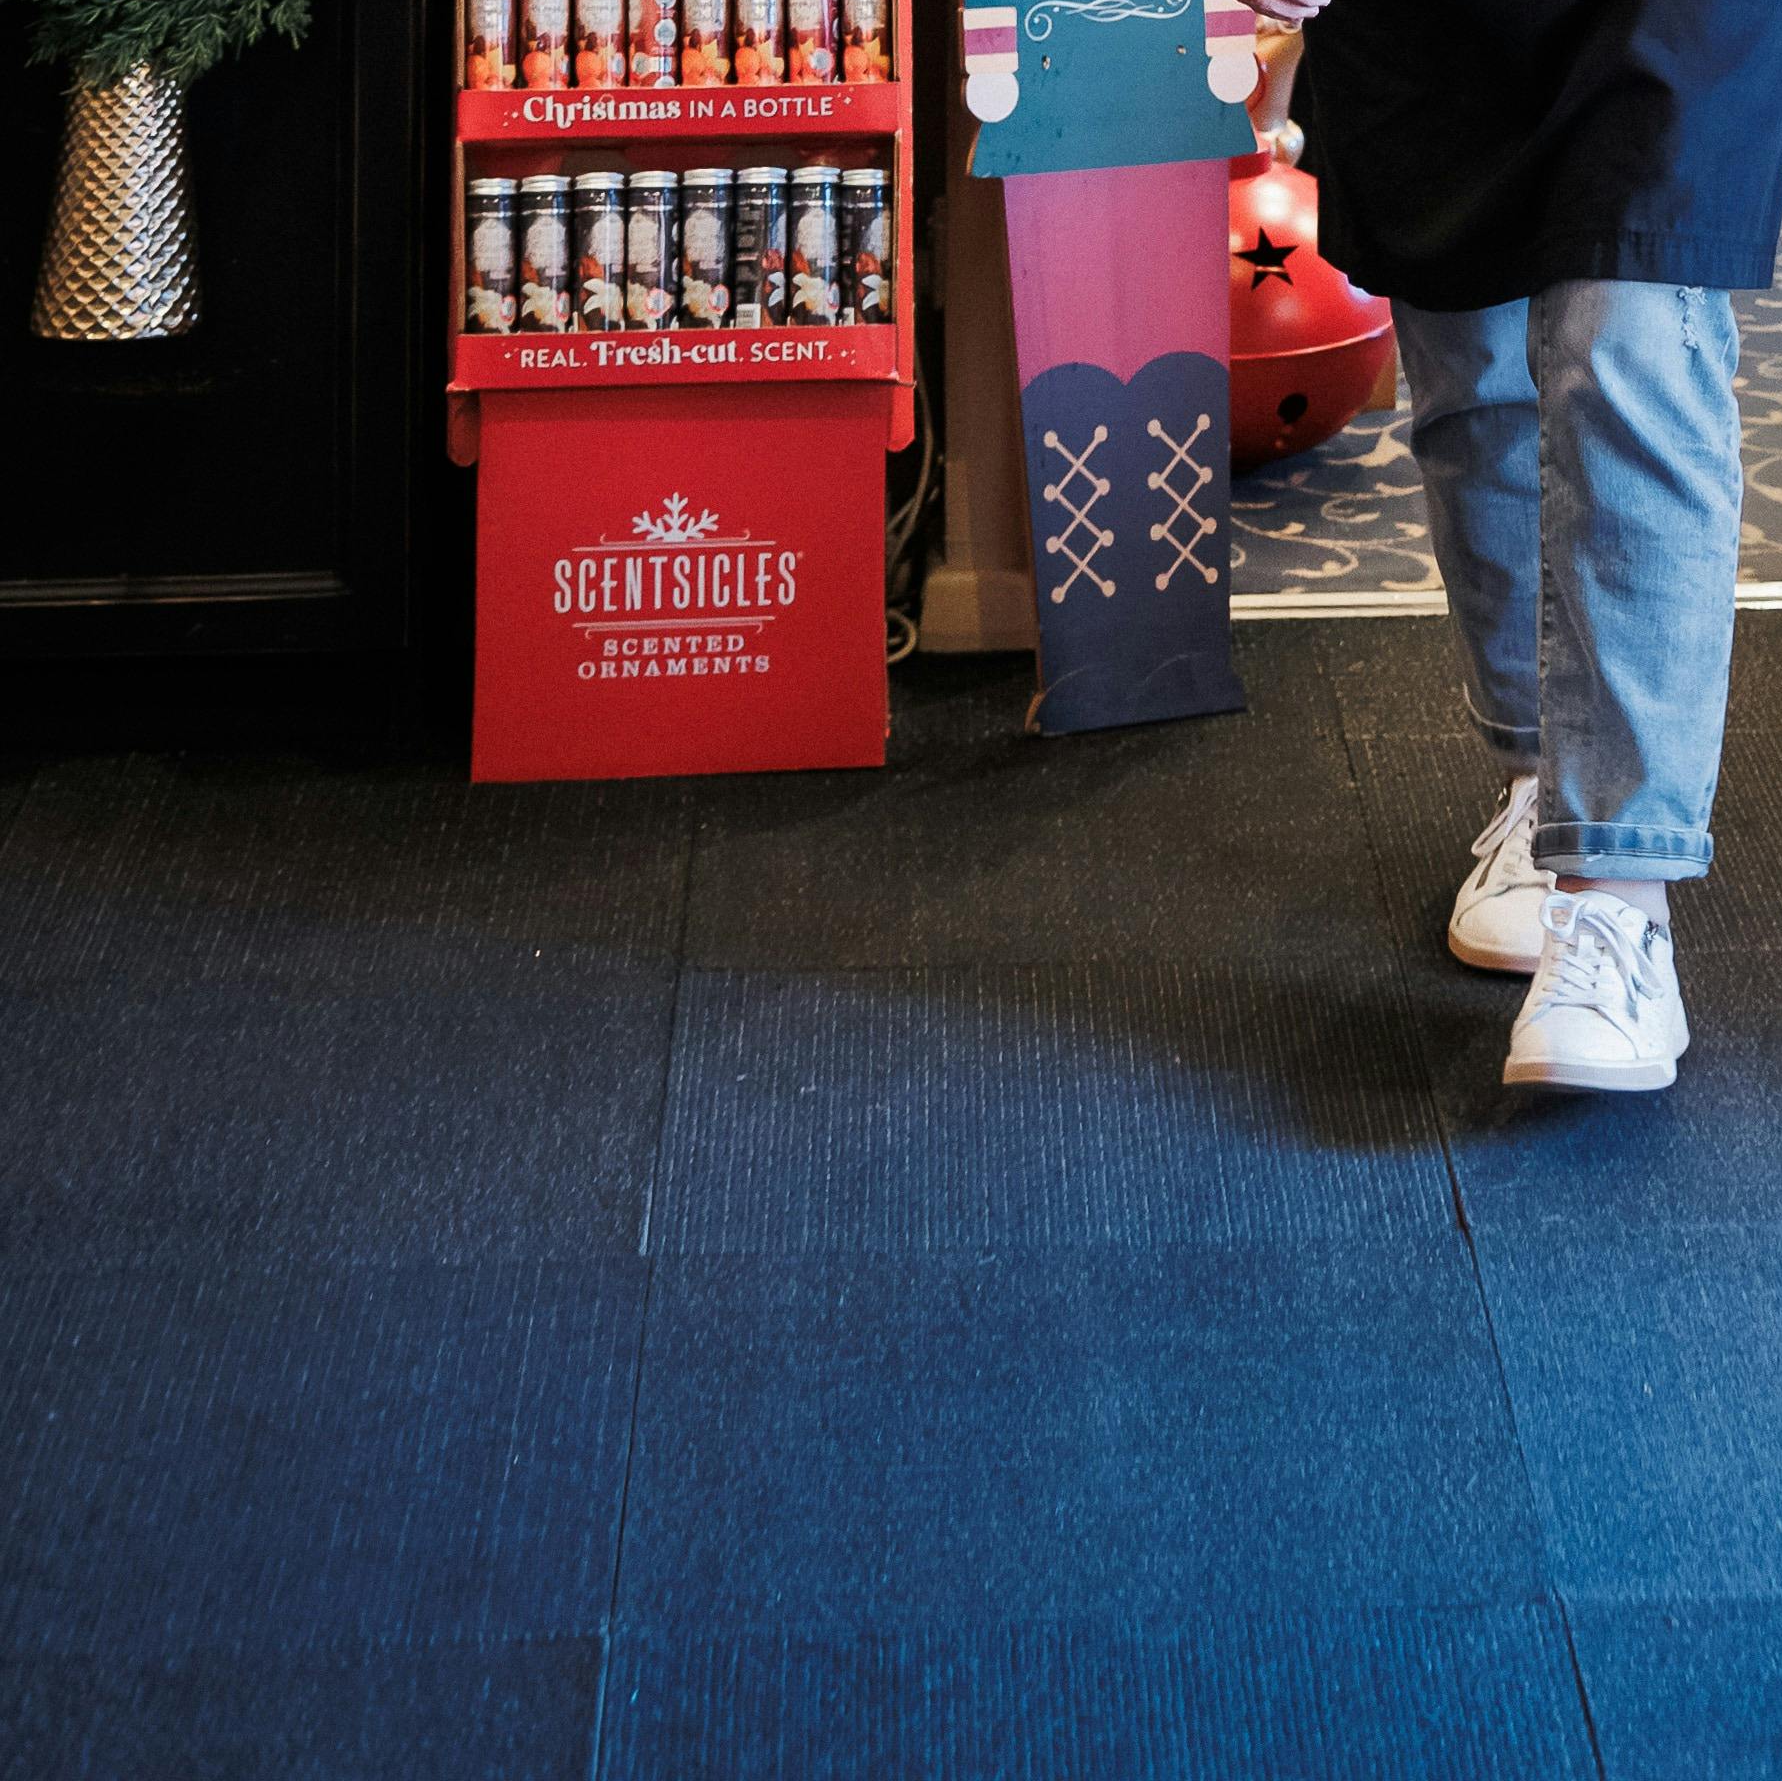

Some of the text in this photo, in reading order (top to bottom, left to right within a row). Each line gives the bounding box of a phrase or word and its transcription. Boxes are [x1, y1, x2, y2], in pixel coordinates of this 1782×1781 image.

[523, 94, 834, 129] Christmas IN A BOTTLE
[520, 348, 588, 369] REAL.
[750, 340, 833, 364] SCENT.
[553, 551, 798, 614] SCENTSICLES
[603, 634, 745, 657] SCENTED
[577, 656, 770, 680] ORNAMENTS
